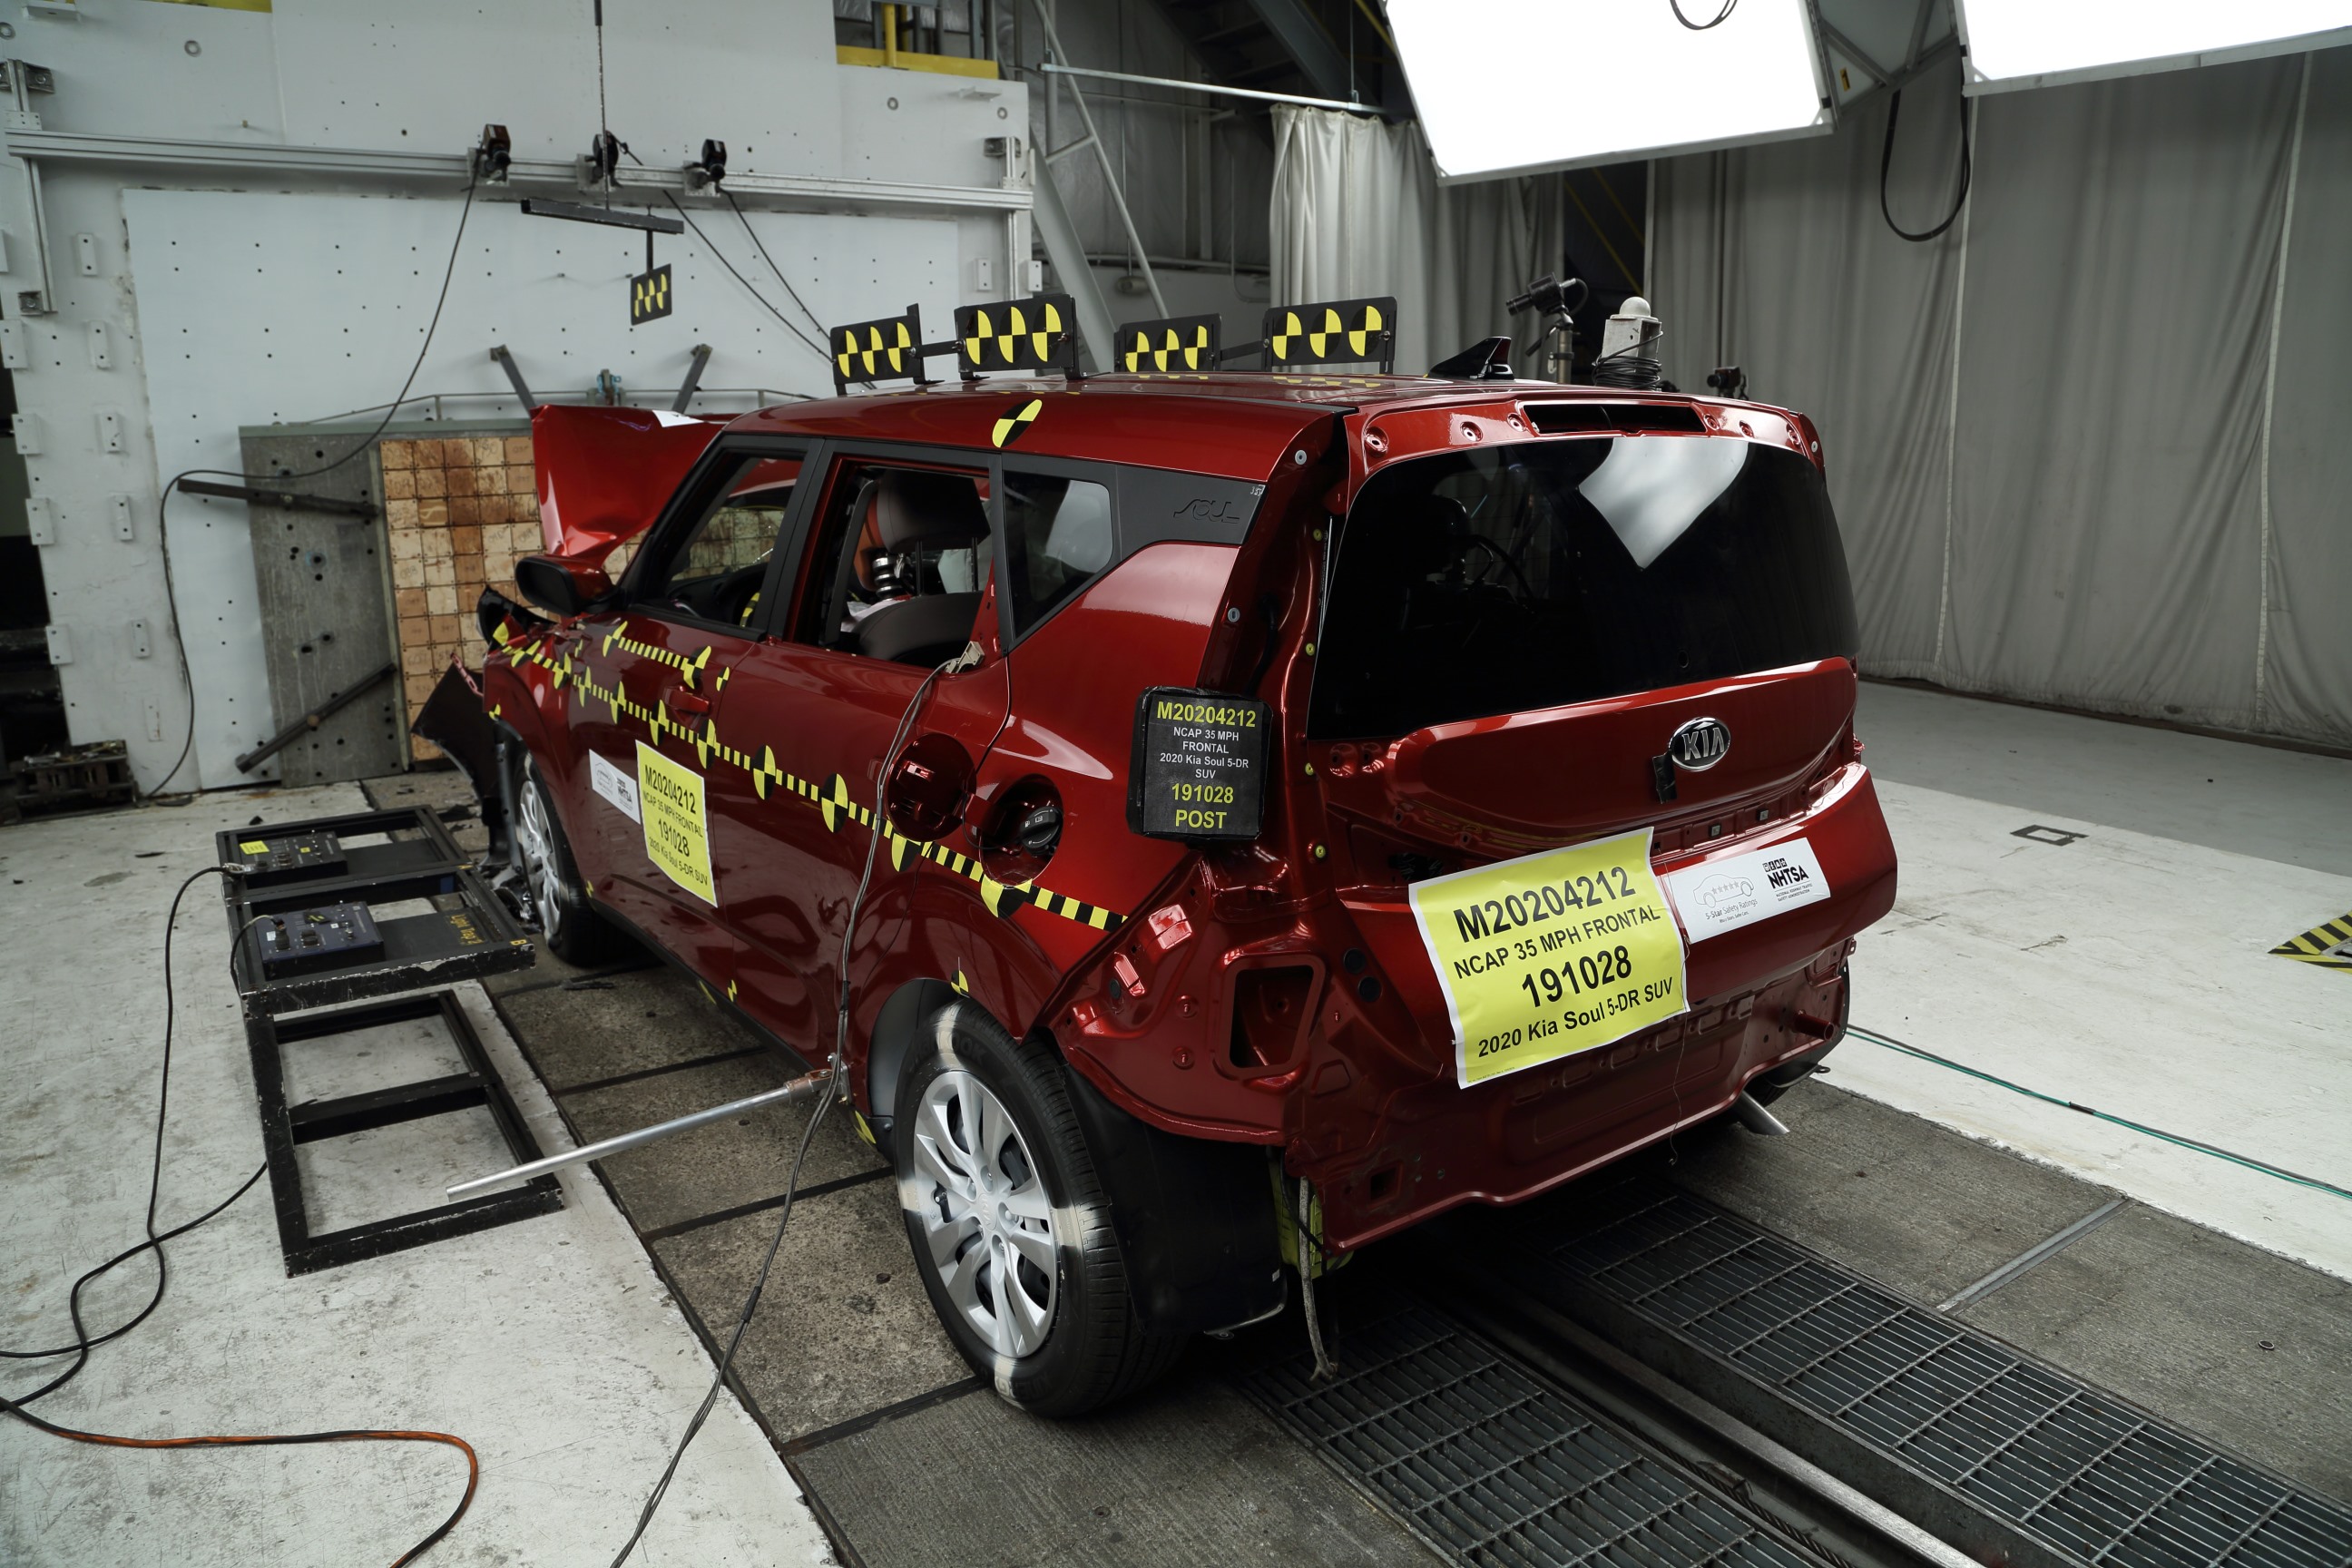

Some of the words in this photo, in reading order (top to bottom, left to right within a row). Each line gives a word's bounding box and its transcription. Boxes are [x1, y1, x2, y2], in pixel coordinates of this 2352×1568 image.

[1157, 701, 1257, 728] M20204212
[1173, 727, 1202, 738] NCAP
[1204, 730, 1216, 740] 35
[1217, 730, 1240, 741] MPH
[1182, 740, 1230, 754] FRONTAL
[1681, 727, 1725, 760] KIA
[1160, 752, 1183, 763] 2020
[1185, 754, 1201, 765] Kia
[1204, 756, 1225, 767] Soul
[1227, 758, 1250, 769] 5-DR
[1195, 769, 1216, 779] SUV
[644, 764, 697, 815] M20204212
[1171, 783, 1234, 804] 191028
[657, 799, 664, 812] 35
[674, 810, 703, 838] FRONTAL
[1175, 809, 1228, 829] POST
[658, 818, 690, 858] 191028
[661, 843, 669, 859] Kia
[678, 859, 694, 879] 5-DR
[694, 869, 708, 887] SUV
[1768, 865, 1809, 889] NHTSA
[1453, 867, 1636, 943] M20204212
[1706, 907, 1723, 920] 5-Star
[1722, 904, 1740, 916] Safety
[1739, 898, 1759, 910] Ratings
[1453, 946, 1509, 979] NCAP
[1514, 939, 1538, 961] 35
[1539, 926, 1582, 953] MPH
[1582, 904, 1661, 939] FRONTAL
[1522, 945, 1632, 1008] 191028
[1478, 1028, 1522, 1057] 2020
[1528, 1020, 1559, 1041] Kia
[1563, 1002, 1605, 1030] Soul
[1607, 989, 1642, 1016] 5-DR
[1644, 976, 1673, 1003] SUV
